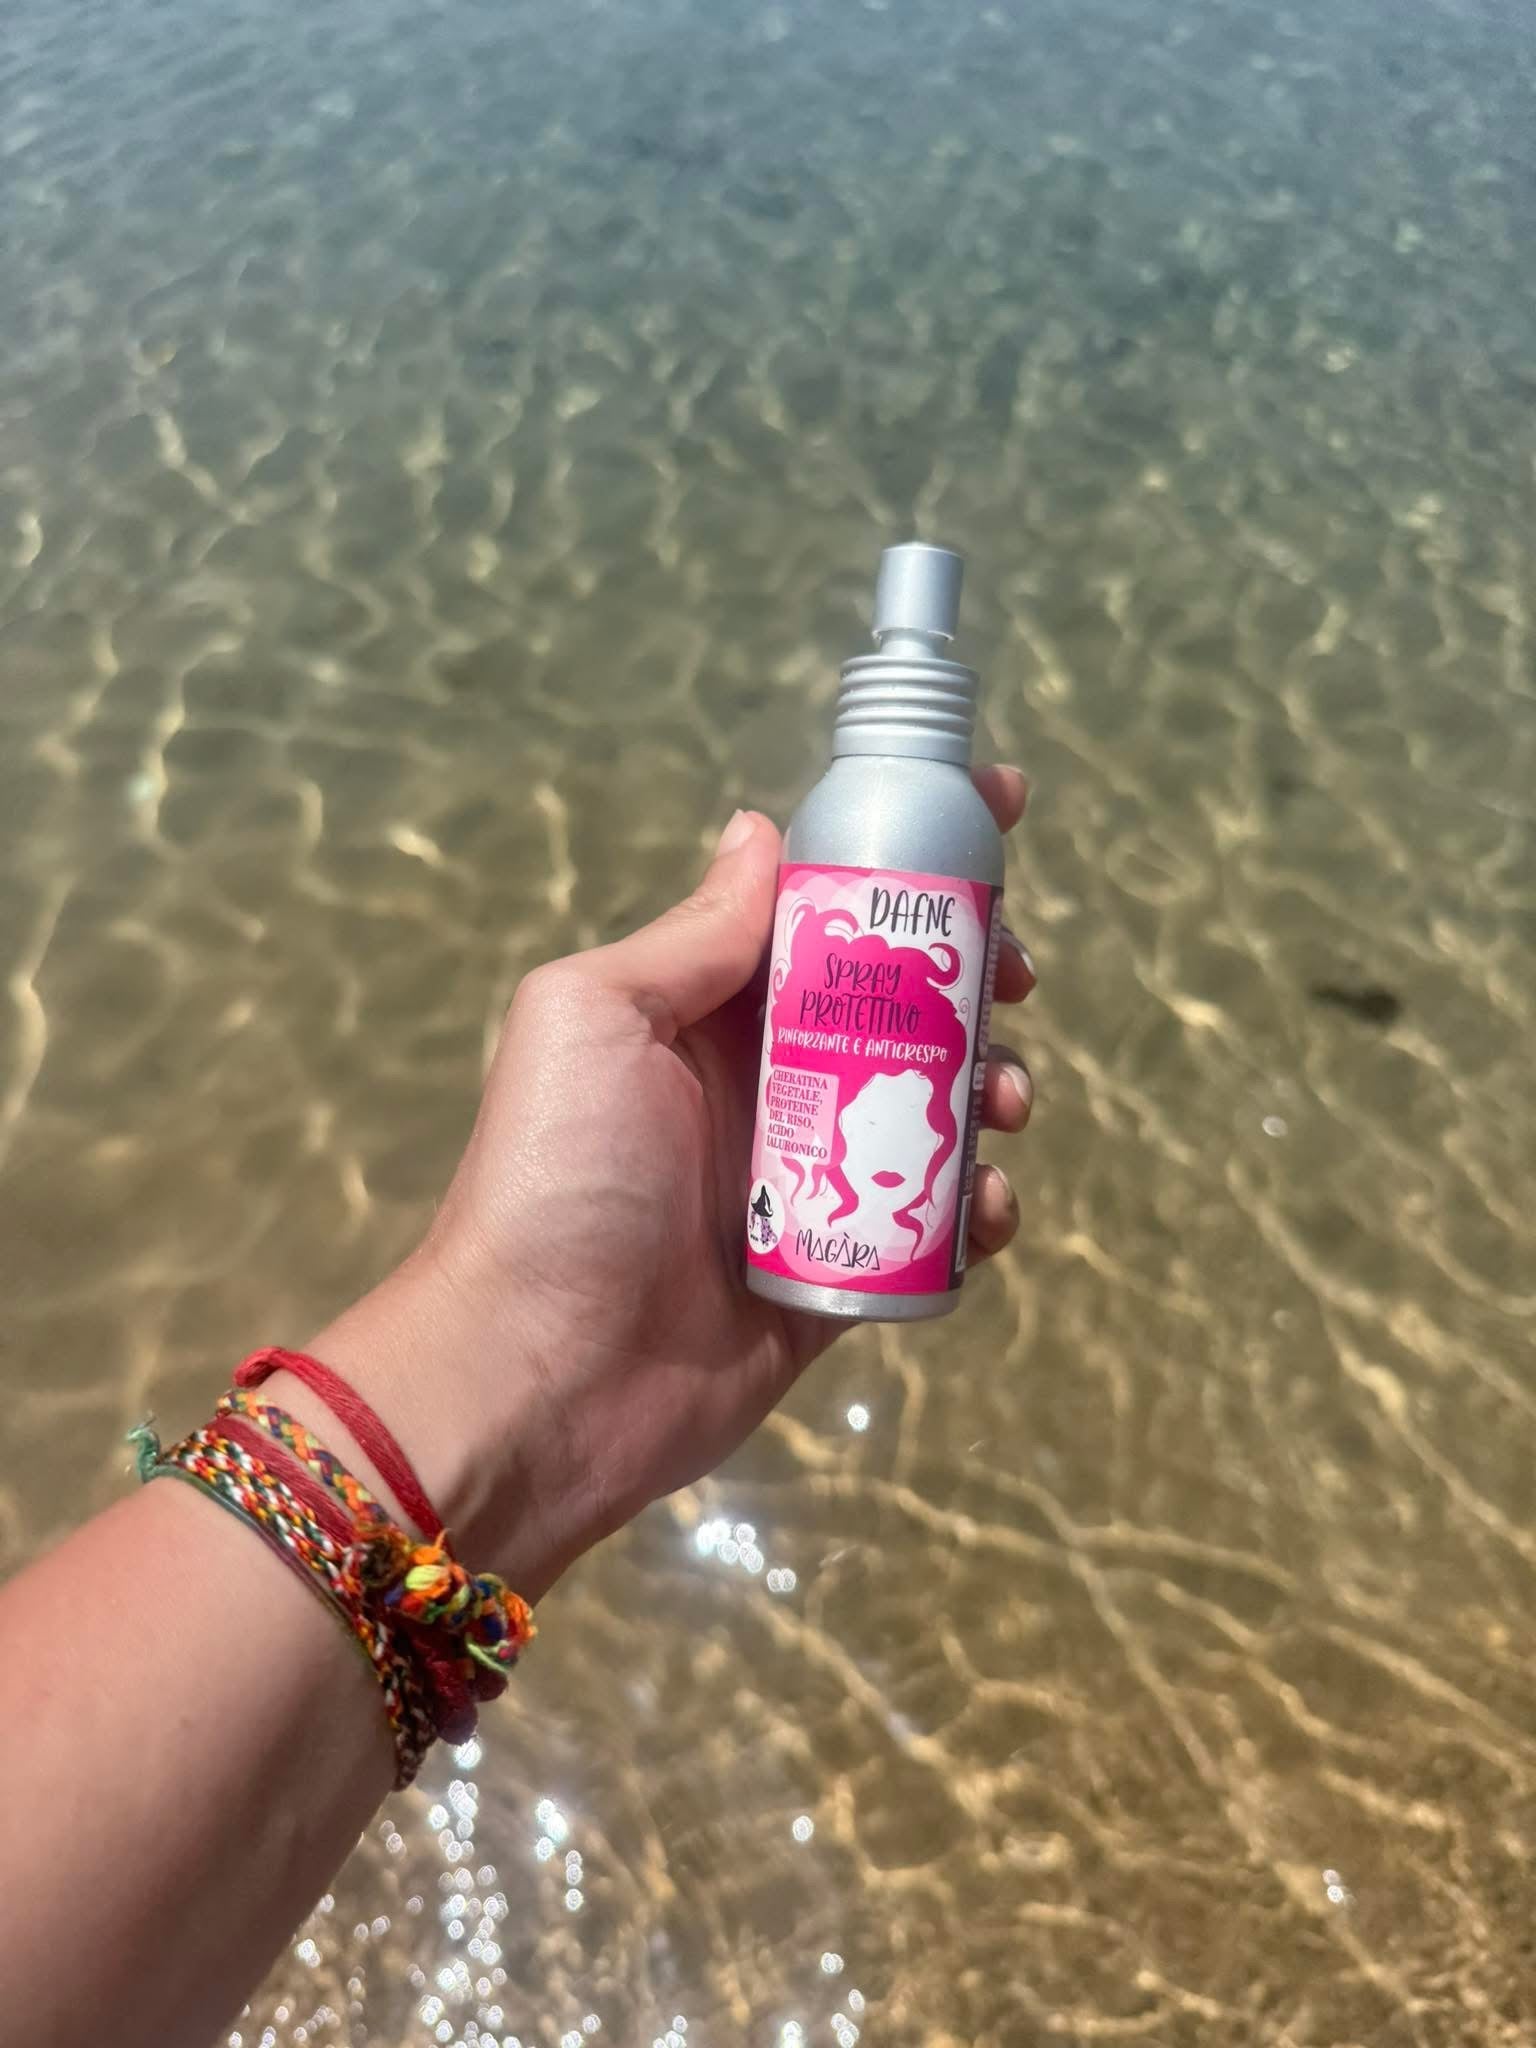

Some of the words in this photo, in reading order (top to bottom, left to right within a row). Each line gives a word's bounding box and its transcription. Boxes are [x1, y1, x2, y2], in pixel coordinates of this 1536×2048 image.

[869, 886, 955, 937] DAFNE
[824, 952, 902, 995] SPRAY
[799, 989, 920, 1036] PROTETTIVO
[777, 1026, 849, 1054] RINFORZANTE
[853, 1037, 863, 1055] E
[865, 1038, 947, 1064] ANTICRESPO
[773, 1069, 828, 1090] CHERATINA
[770, 1095, 819, 1116] PROTEINE
[772, 1082, 822, 1105] VEGETALE,
[769, 1108, 785, 1123] DEL
[767, 1122, 795, 1139] ACIDO
[766, 1134, 828, 1159] IALURONICO
[796, 1228, 880, 1271] MAGÀRA
